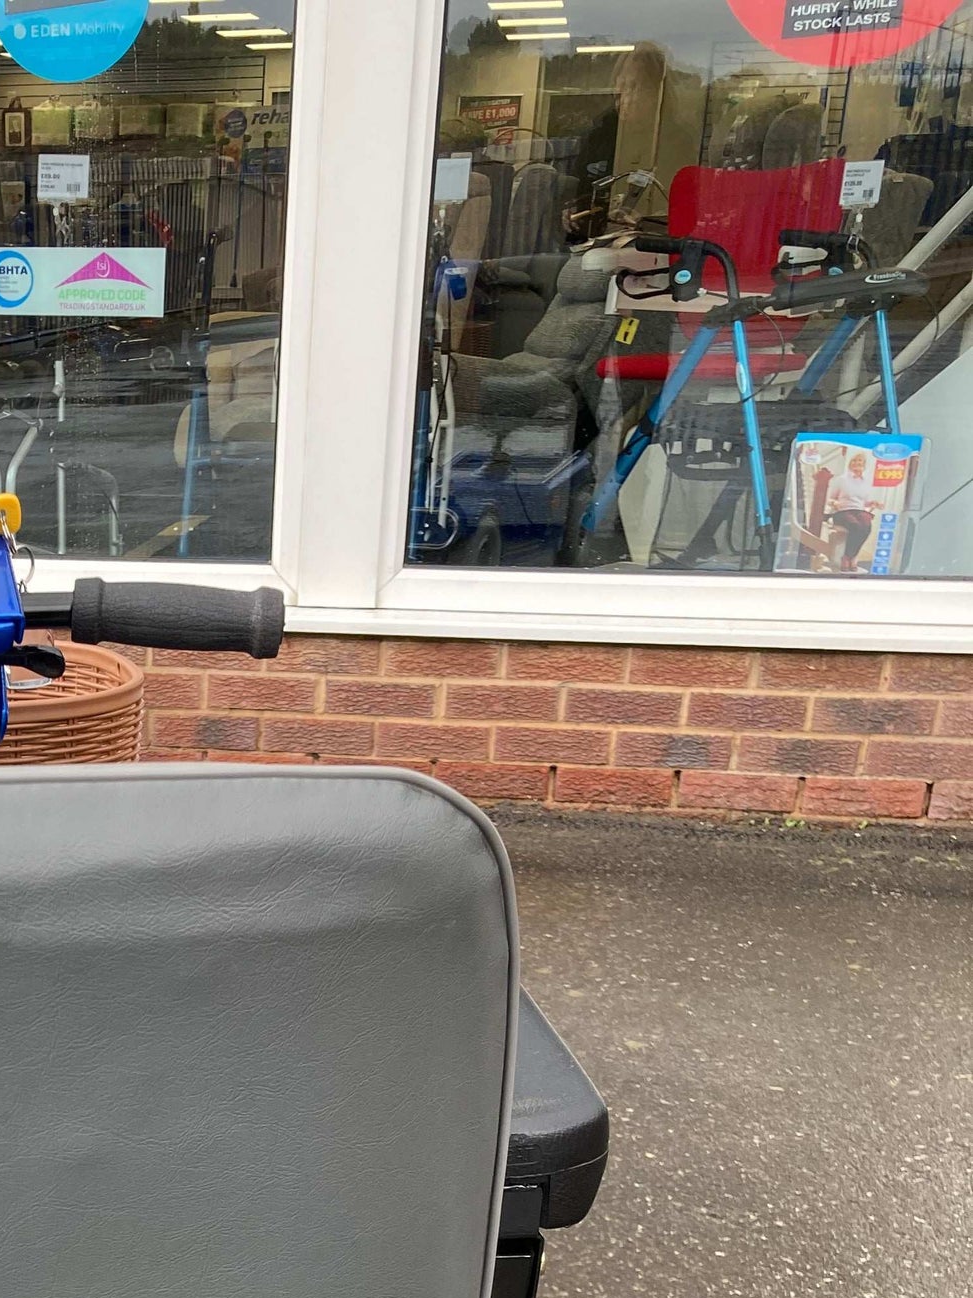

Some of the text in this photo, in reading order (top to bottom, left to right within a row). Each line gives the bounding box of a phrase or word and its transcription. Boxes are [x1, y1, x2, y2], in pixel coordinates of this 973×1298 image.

[790, 2, 840, 16] HURRY
[853, 0, 898, 10] WHILE
[31, 22, 124, 38] EDEN Mobility
[793, 12, 891, 32] STOCK LASTS
[58, 288, 146, 301] APPROVED CODE
[59, 302, 146, 311] TRADINGSTANDARDS.UK
